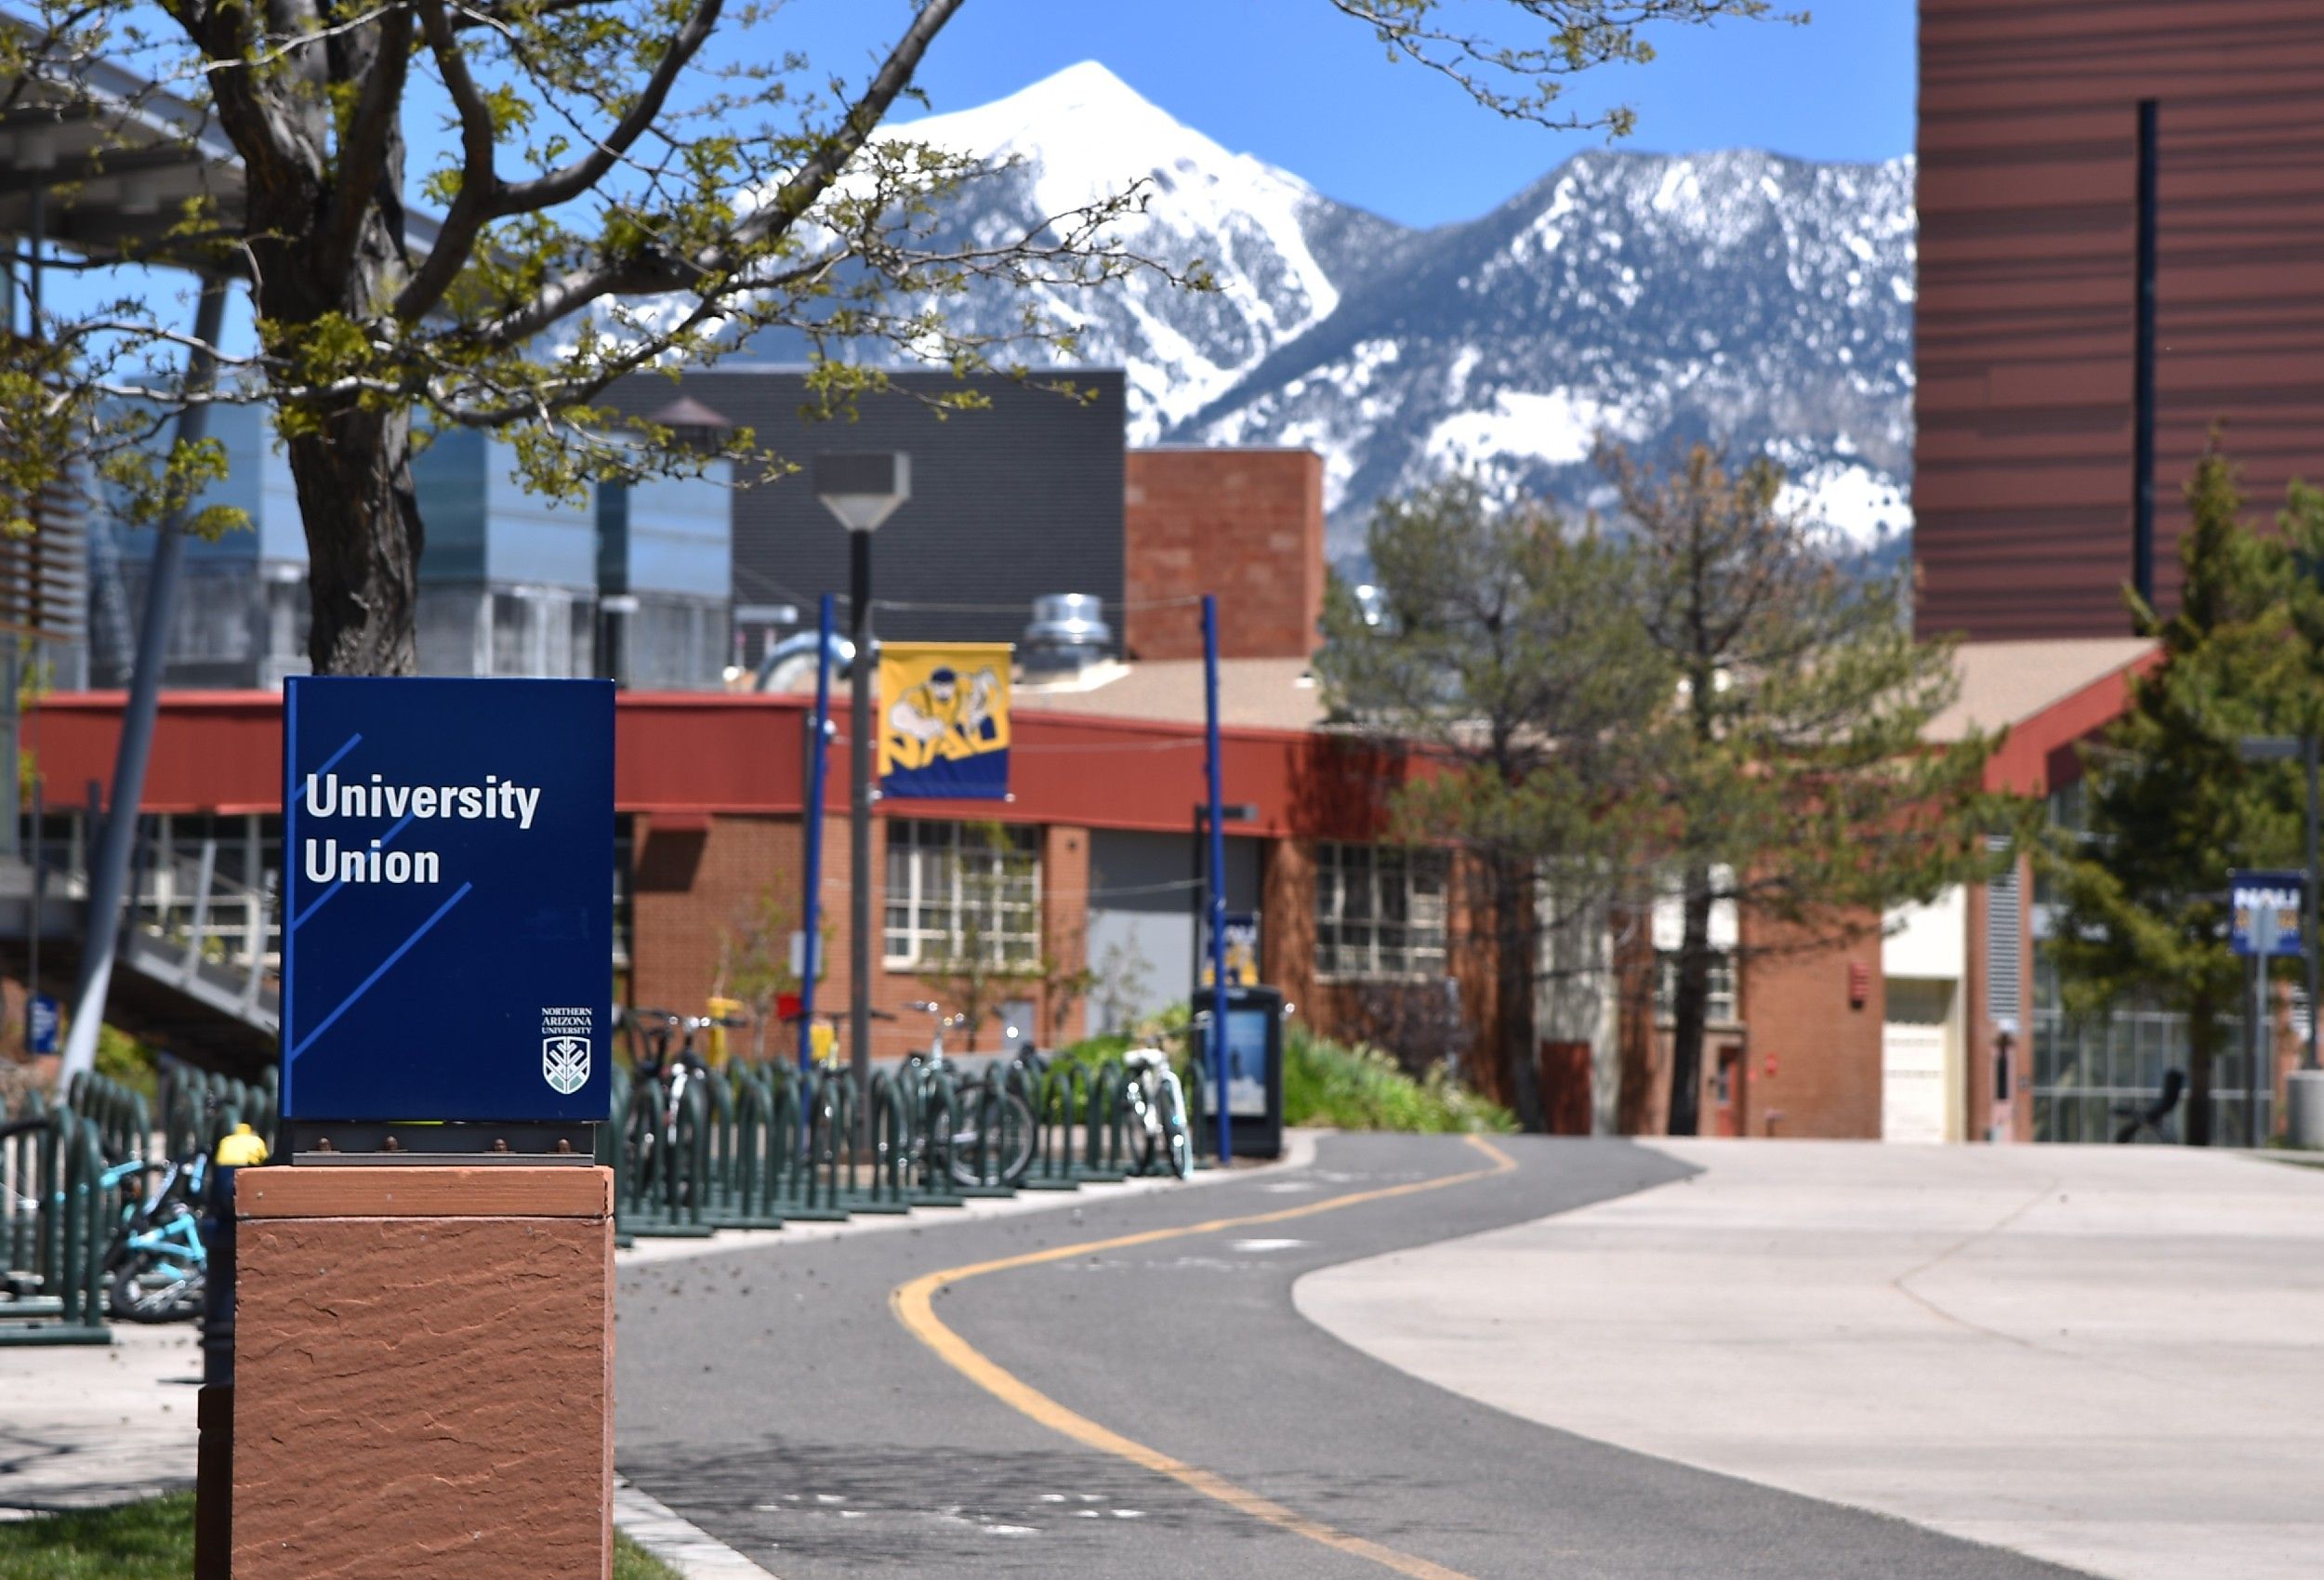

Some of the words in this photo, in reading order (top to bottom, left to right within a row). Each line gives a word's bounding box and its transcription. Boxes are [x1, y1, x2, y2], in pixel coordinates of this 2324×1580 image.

[306, 773, 541, 829] University
[306, 838, 440, 884] Union
[542, 1007, 592, 1016] NORTHERN
[542, 1016, 592, 1026] ARIZONA
[542, 1026, 592, 1034] UNIVERSITY
